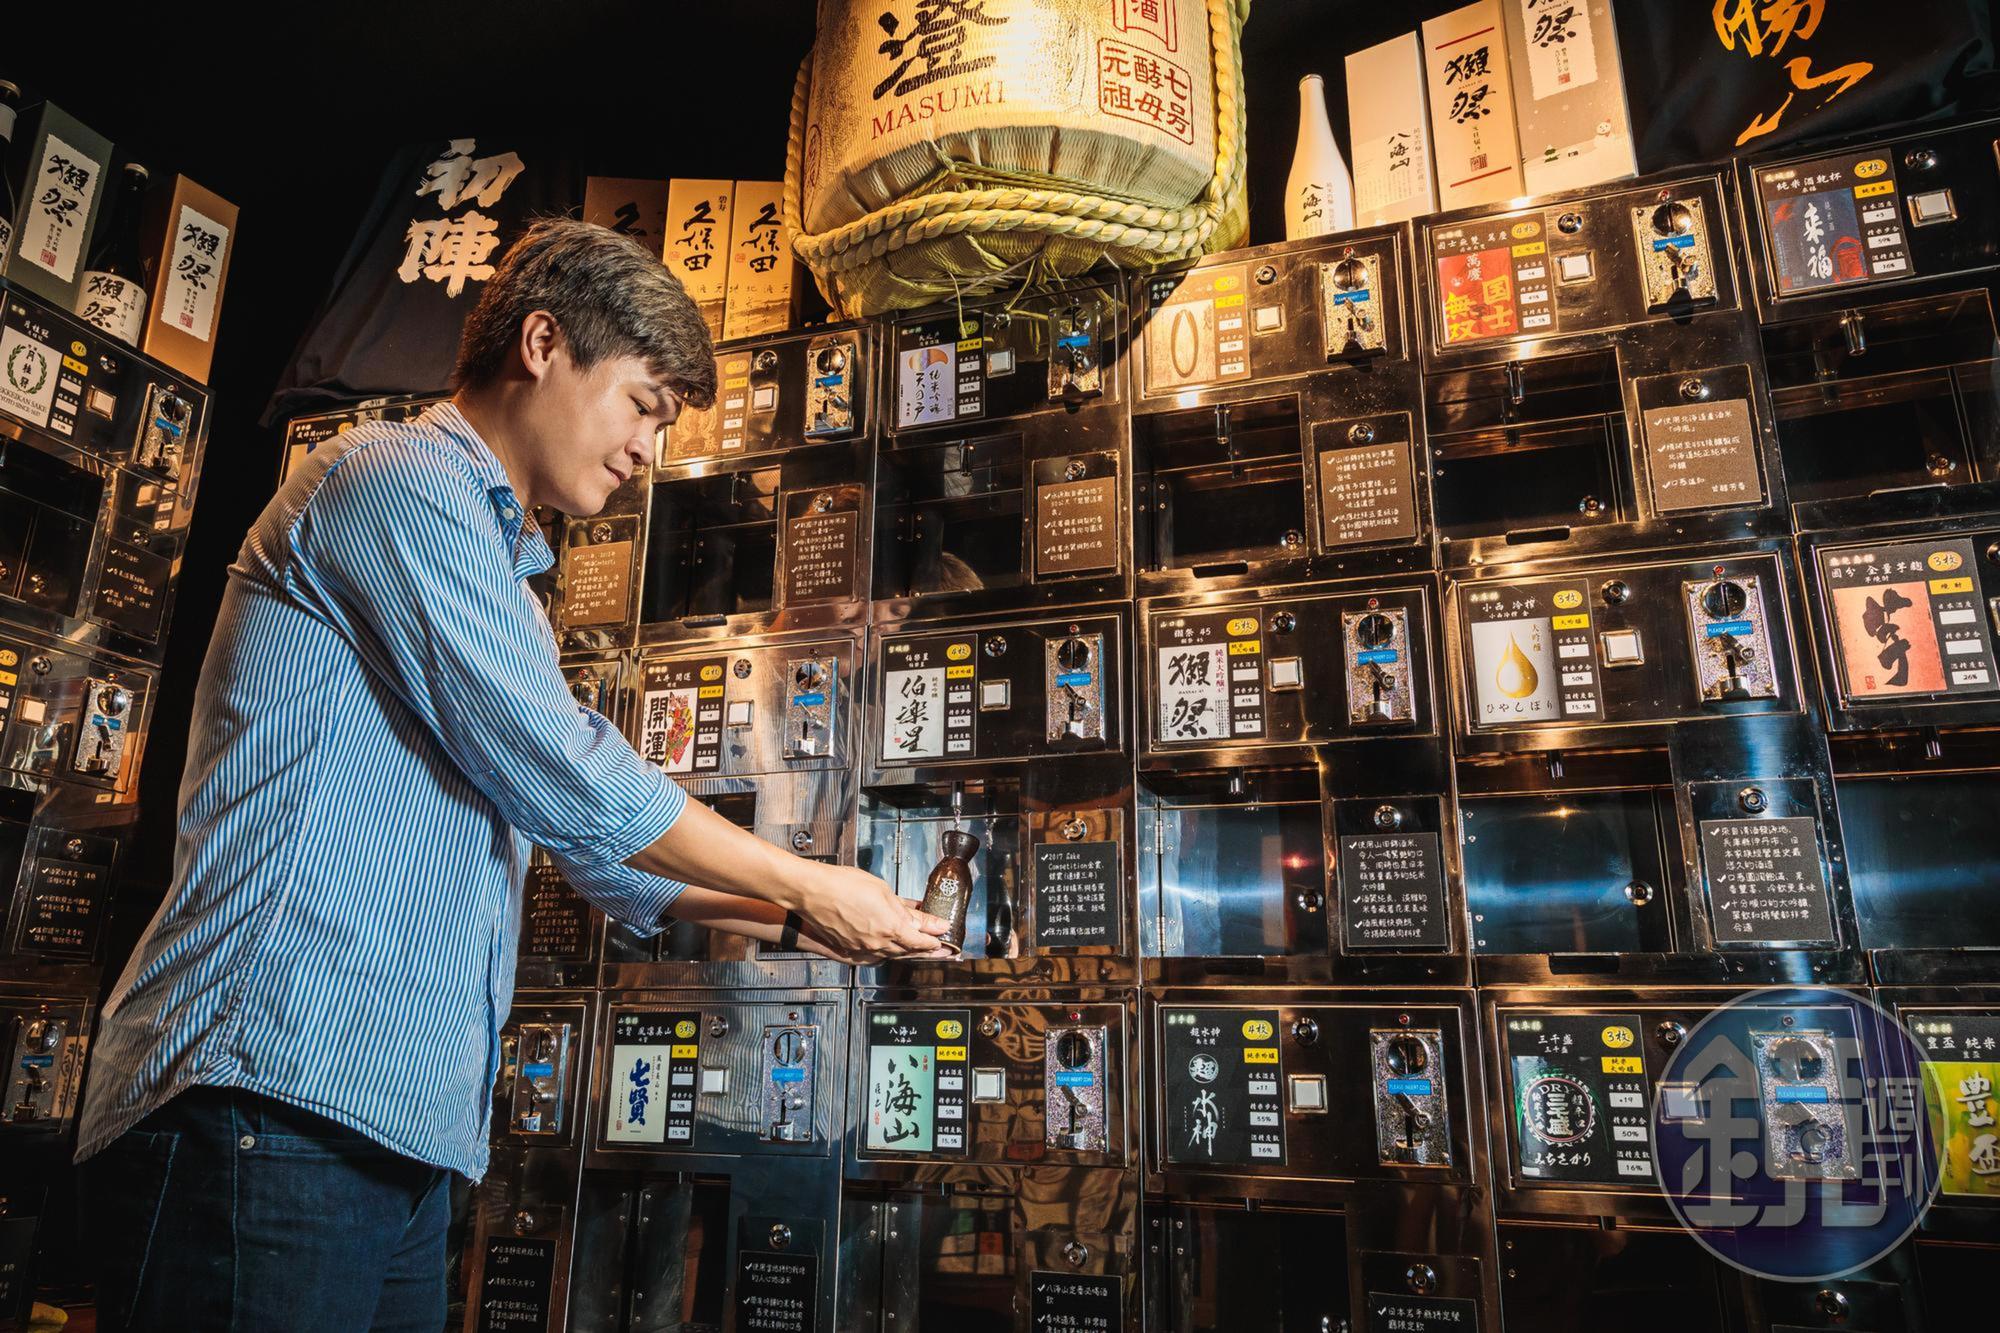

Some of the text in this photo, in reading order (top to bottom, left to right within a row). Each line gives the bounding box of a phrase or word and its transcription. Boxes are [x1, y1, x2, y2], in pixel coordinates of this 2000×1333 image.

[1103, 46, 1135, 111] 元祖
[1134, 54, 1166, 122] 酵母
[1444, 45, 1497, 124] 獺祭
[871, 80, 1006, 141] MASUMI
[1164, 67, 1190, 135] 七号
[1388, 131, 1411, 172] 八海山
[39, 154, 91, 228] 獺祭
[1300, 183, 1324, 222] 八海山
[176, 222, 222, 290] 獺祭
[675, 200, 717, 271] 久保田
[741, 202, 782, 273] 久保田
[20, 347, 35, 389] 月桂冠
[1933, 555, 1958, 566] 3枚
[1556, 592, 1579, 604] 3枚
[1200, 627, 1212, 636] 45
[1167, 650, 1214, 738] 獺祭
[678, 1023, 694, 1034] 3枚
[888, 1026, 918, 1036] 八海山
[942, 1022, 962, 1035] 4枚
[1247, 1024, 1269, 1037] 4枚
[1538, 1033, 1574, 1046] 三千盛
[1606, 1030, 1631, 1043] 3枚
[1965, 1037, 1996, 1050] 純米
[628, 1057, 650, 1127] 七賢
[883, 1054, 922, 1144] 八海山
[1608, 1083, 1641, 1092] 日本酒度
[1188, 1089, 1219, 1157] 水神
[1621, 1130, 1640, 1138] 50%
[1625, 1164, 1643, 1172] 16%
